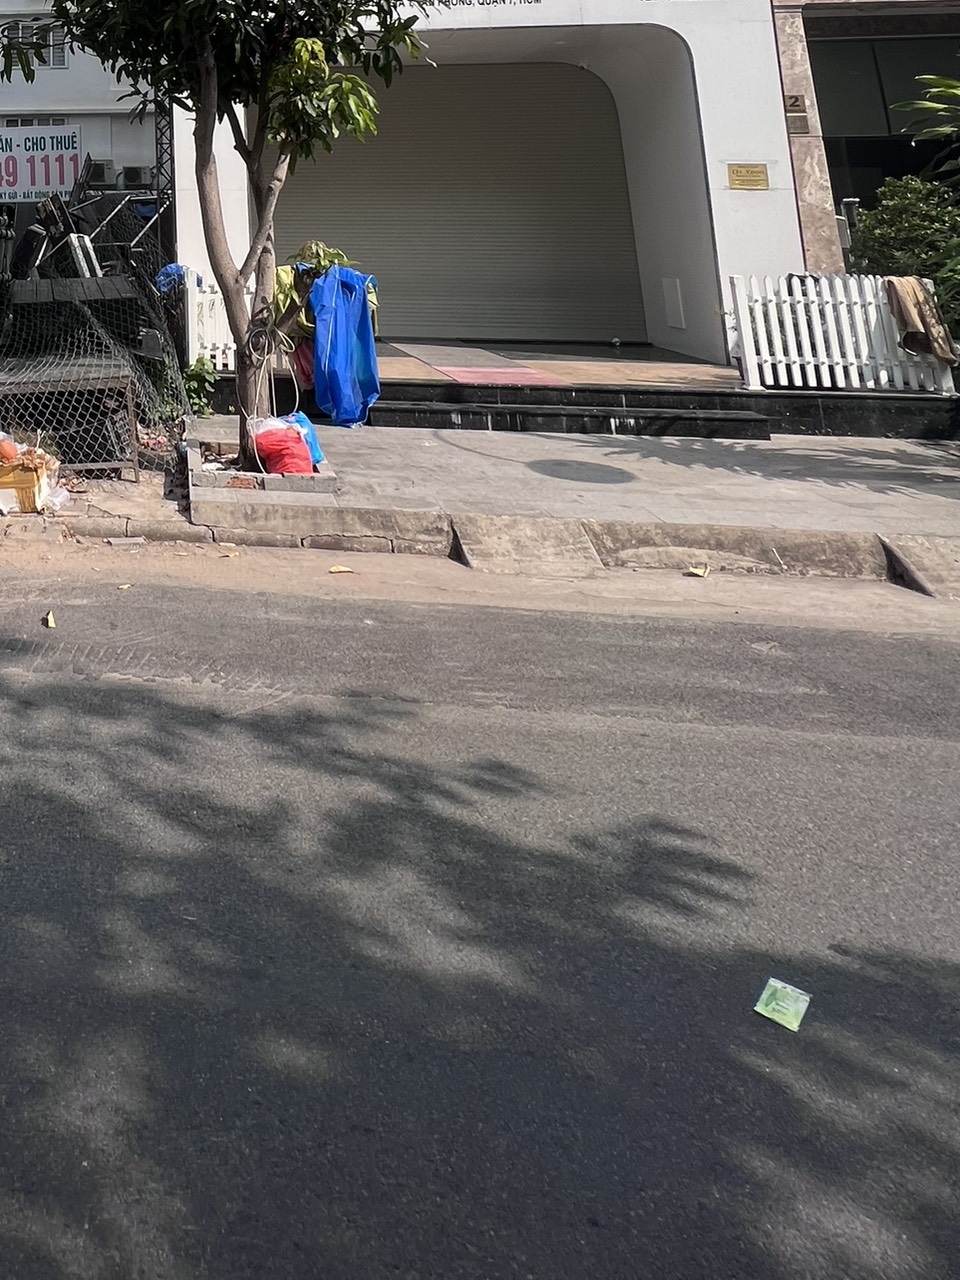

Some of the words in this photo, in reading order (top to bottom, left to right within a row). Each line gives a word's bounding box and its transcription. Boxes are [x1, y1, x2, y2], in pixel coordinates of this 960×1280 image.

[24, 136, 46, 151] CHO
[49, 131, 78, 151] THUÊ
[26, 153, 79, 187] 1111
